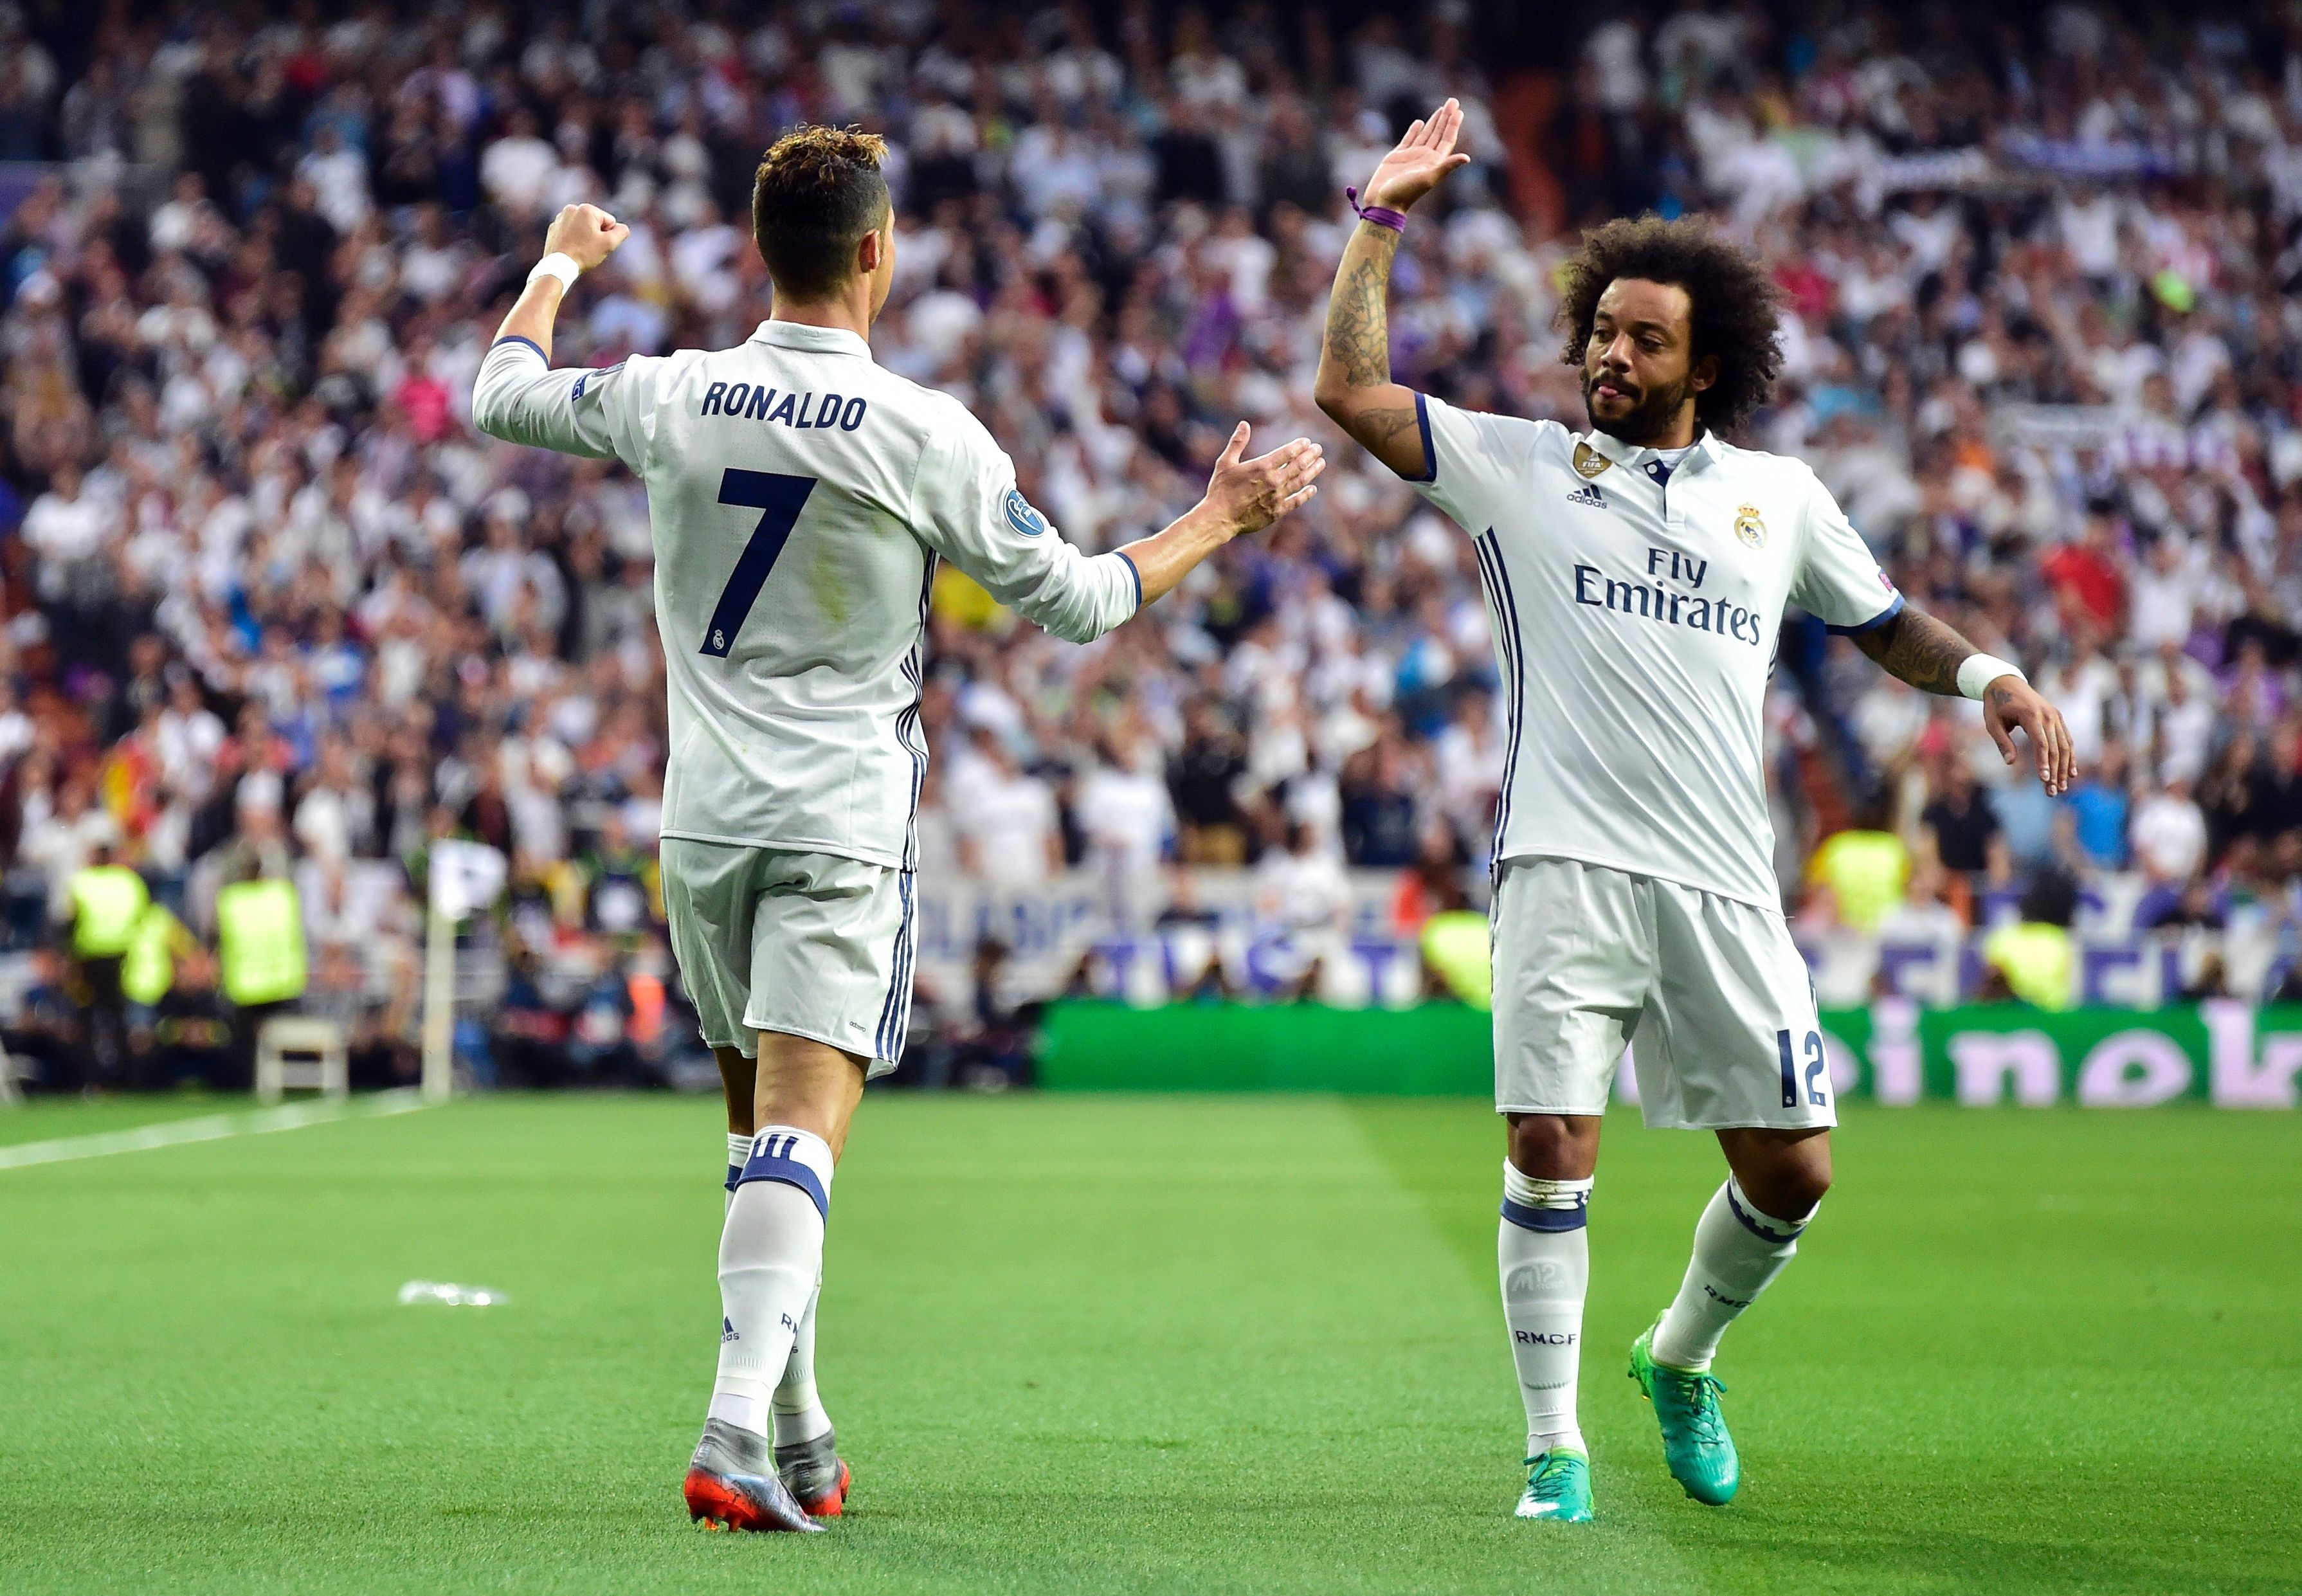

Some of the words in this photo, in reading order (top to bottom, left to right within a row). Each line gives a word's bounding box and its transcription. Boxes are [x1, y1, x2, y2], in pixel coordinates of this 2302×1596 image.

[700, 381, 867, 431] RONALDO
[1566, 493, 1608, 509] adidas
[698, 467, 819, 659] 7
[1647, 547, 1707, 588] Fly
[1573, 563, 1761, 646] Emirates
[1777, 1029, 1826, 1108] 12
[1704, 1285, 1751, 1308] RMC
[1515, 1329, 1577, 1345] RMCF
